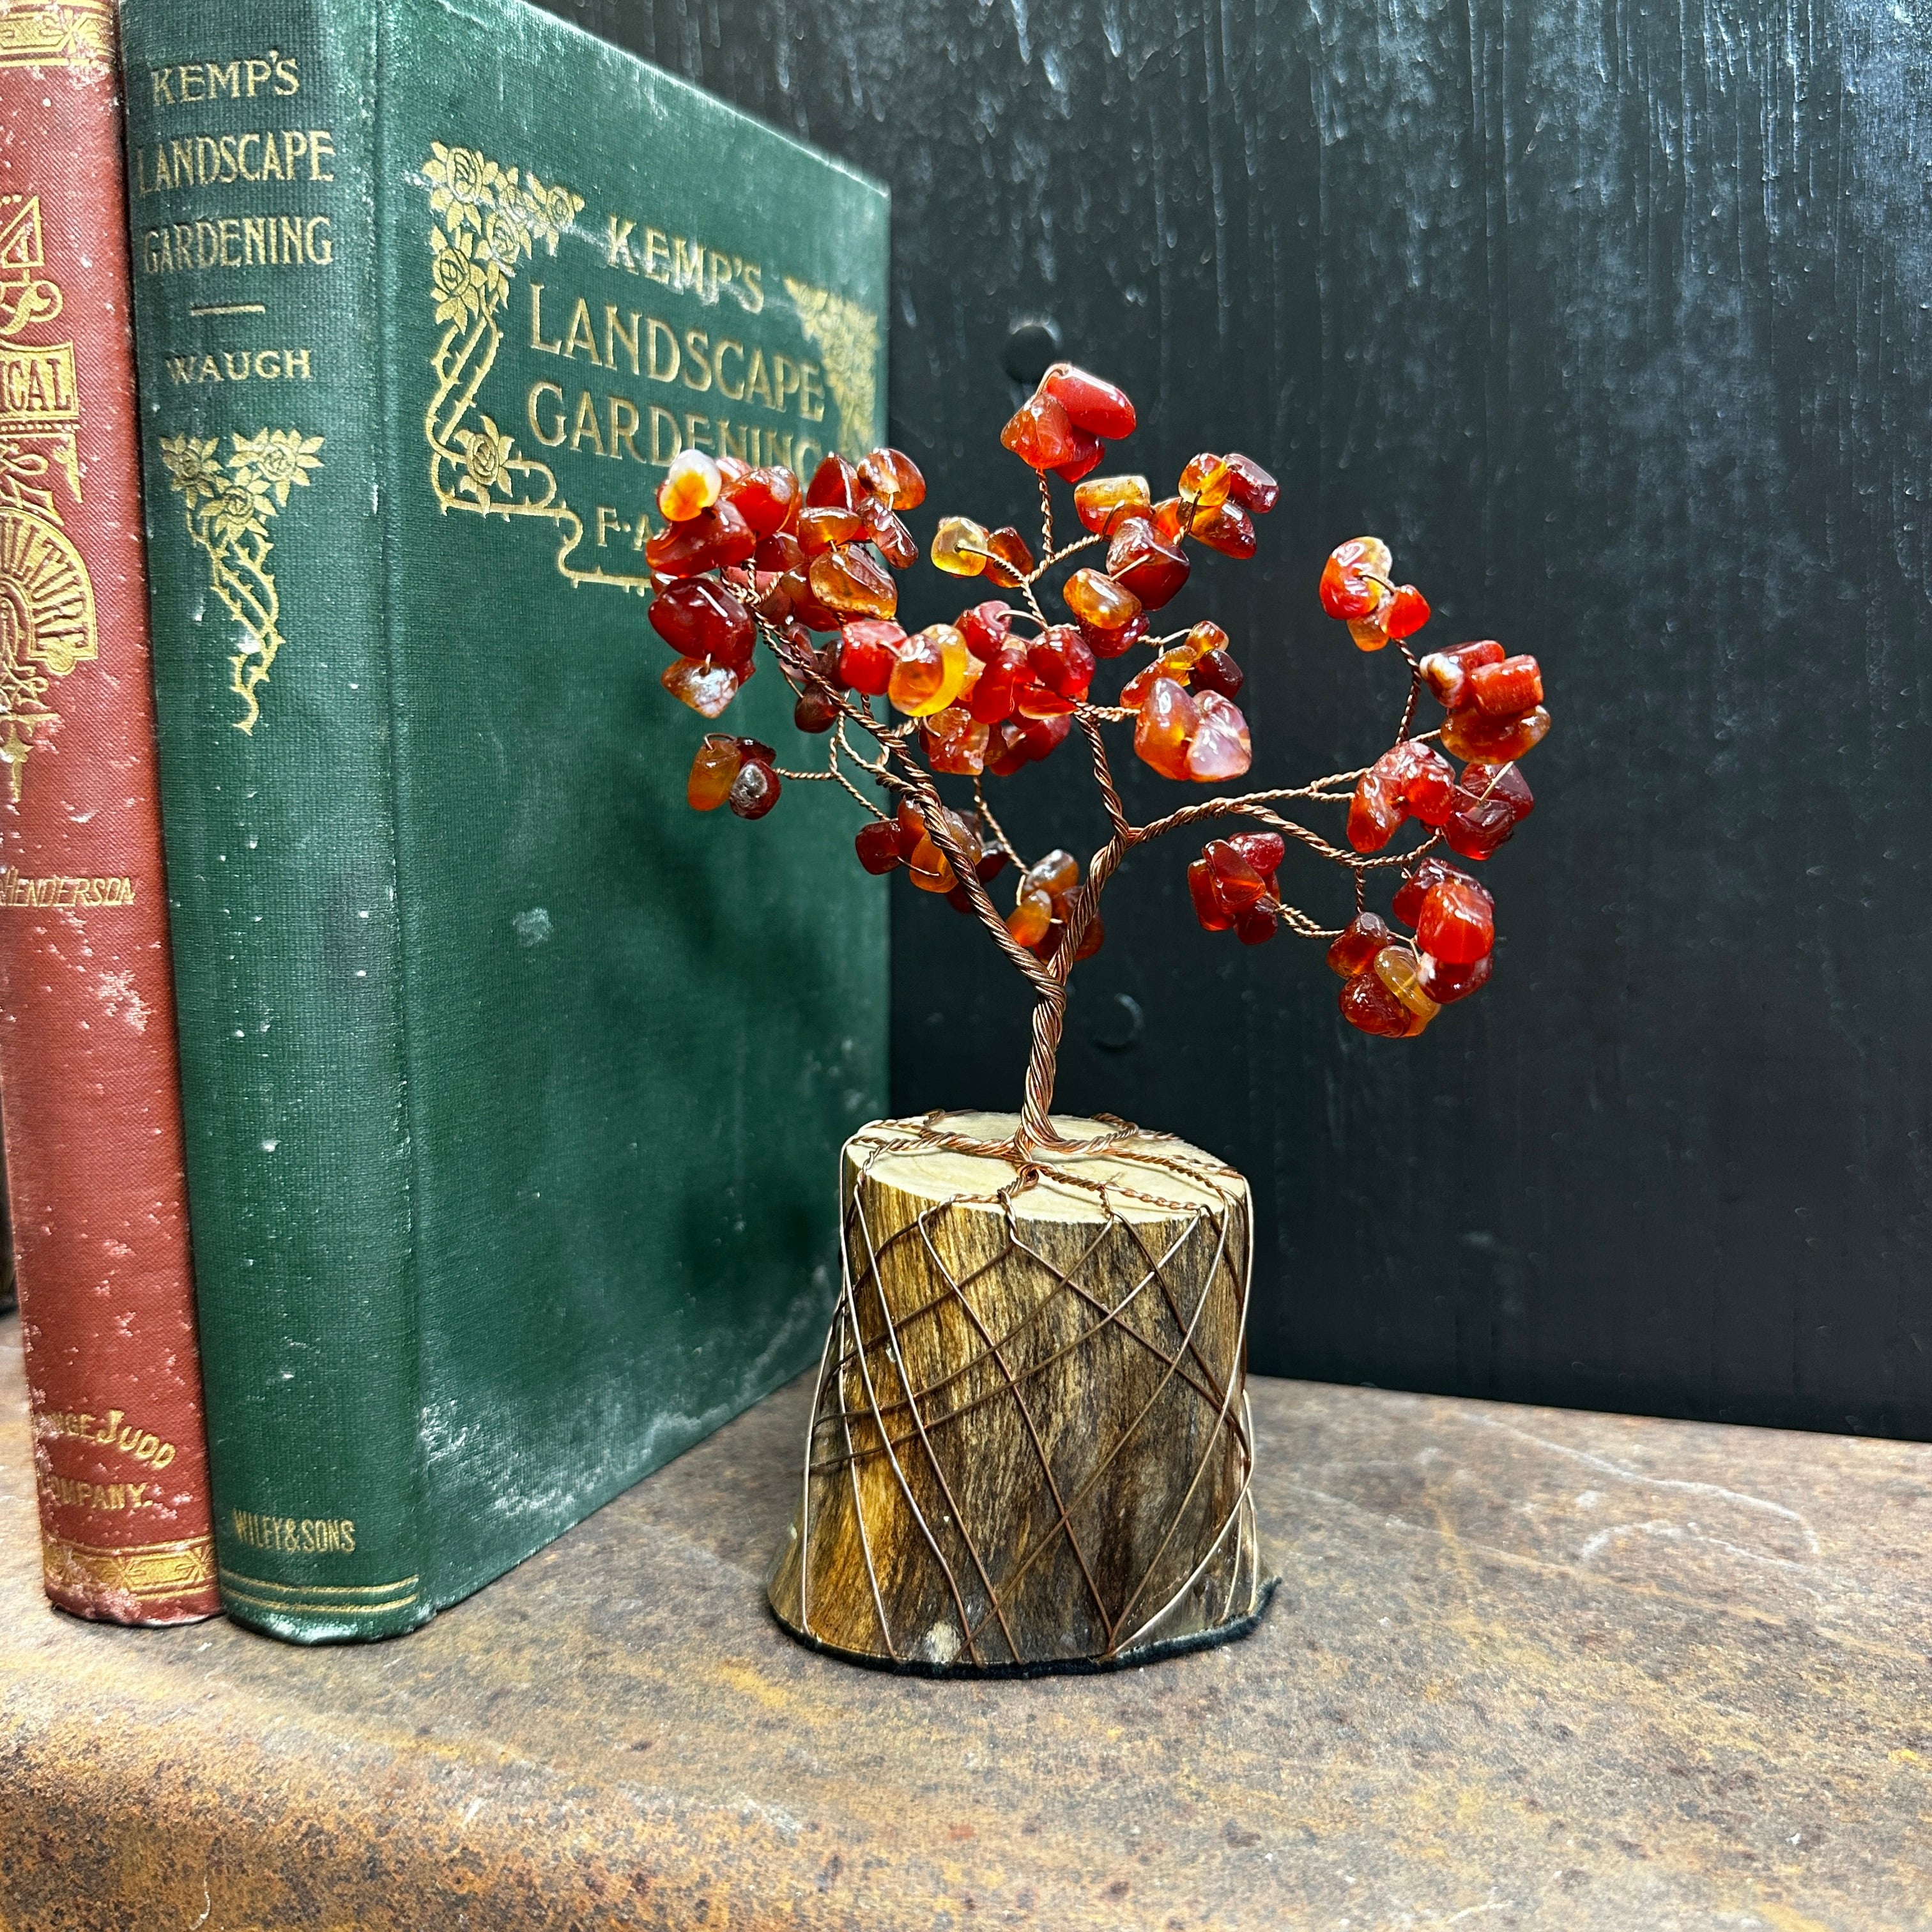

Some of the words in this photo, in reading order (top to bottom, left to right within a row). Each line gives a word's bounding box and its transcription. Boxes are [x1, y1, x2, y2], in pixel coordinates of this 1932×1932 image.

[151, 50, 300, 107] KEMP'S
[137, 130, 336, 197] LANDSCAPE
[144, 216, 334, 275] GARDENING
[607, 213, 764, 314] KEMP'S
[165, 349, 312, 385] WAUGH
[530, 282, 825, 422] LANDSCAPE
[96, 1409, 176, 1470] JUDD
